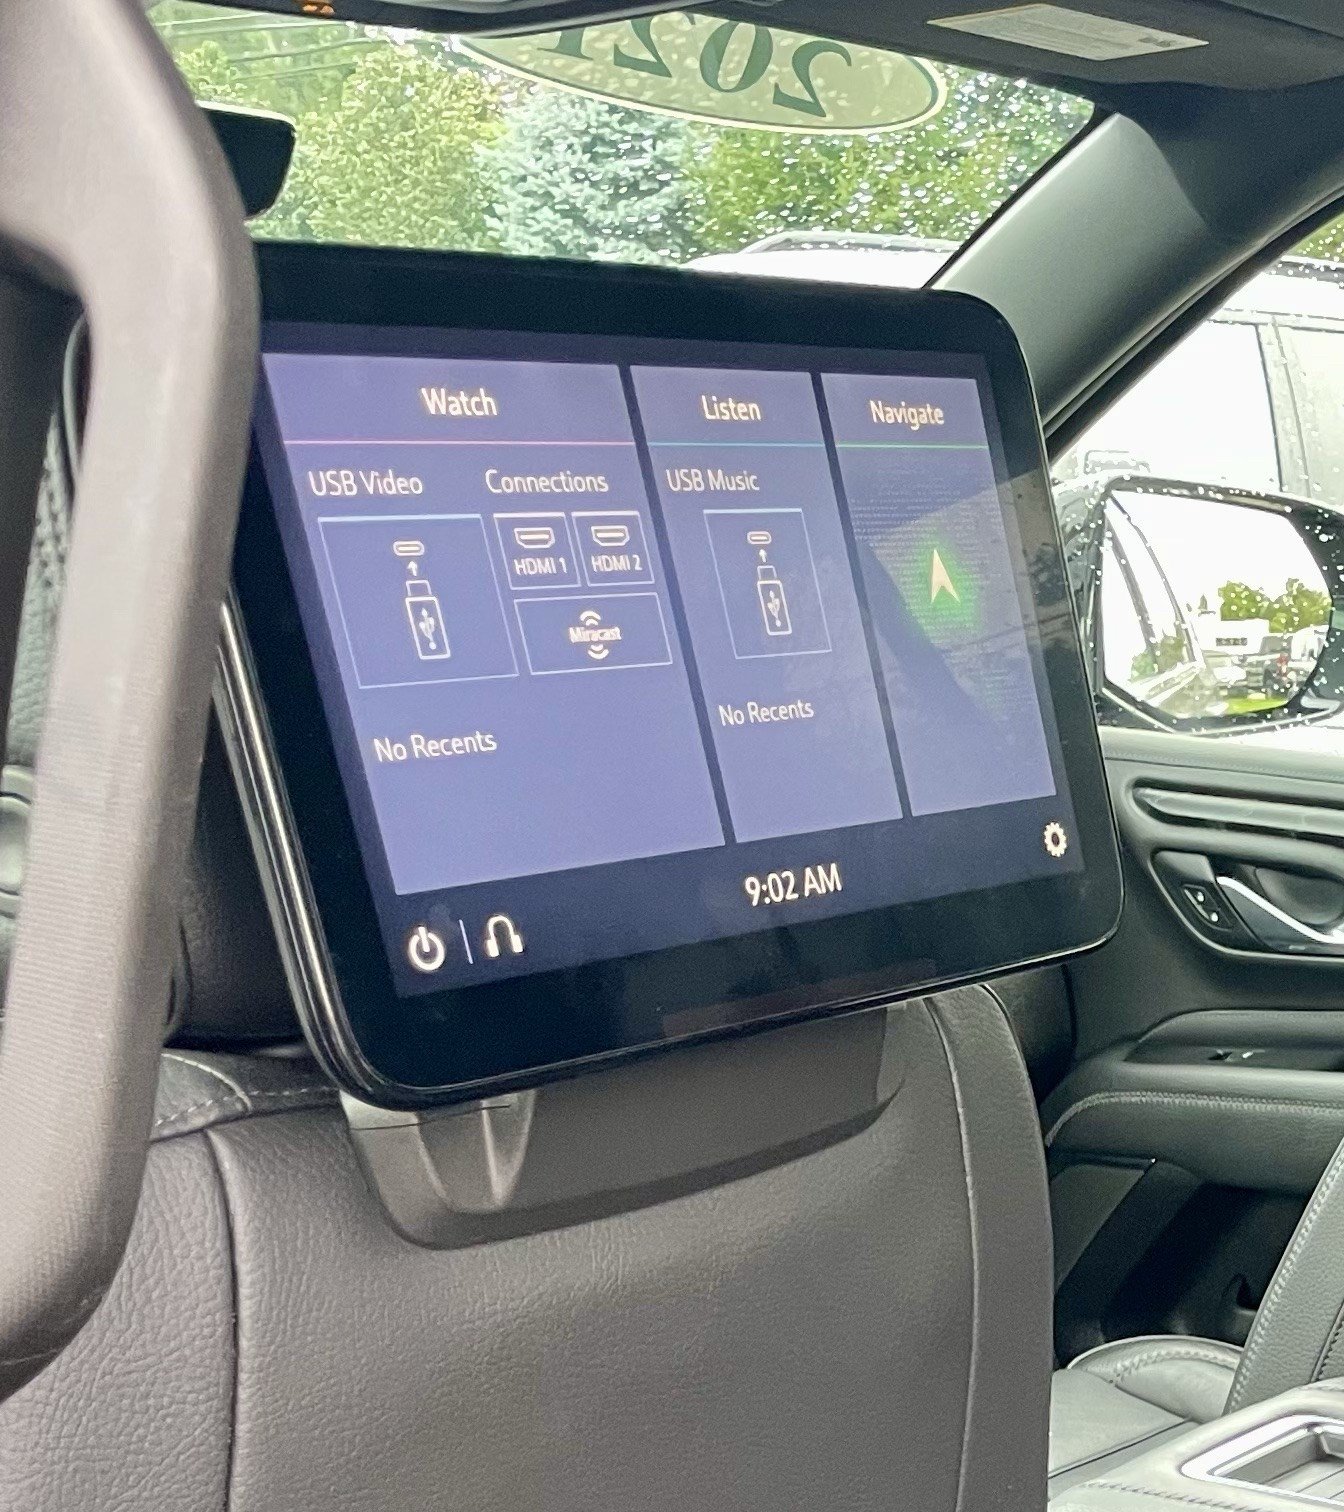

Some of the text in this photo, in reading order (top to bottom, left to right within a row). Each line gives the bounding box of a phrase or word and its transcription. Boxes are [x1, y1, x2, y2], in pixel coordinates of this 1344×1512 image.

[421, 387, 498, 416] Watch
[701, 395, 762, 421] Listen
[869, 400, 945, 431] Navigate
[308, 469, 423, 496] USB Video
[485, 469, 609, 494] Connections
[665, 469, 760, 492] USB Music
[513, 557, 568, 576] HDMI 1
[591, 554, 643, 573] HDMI 2
[718, 700, 815, 727] No Recents
[373, 730, 498, 763] No Recents
[744, 862, 843, 908] 9:02 AM
